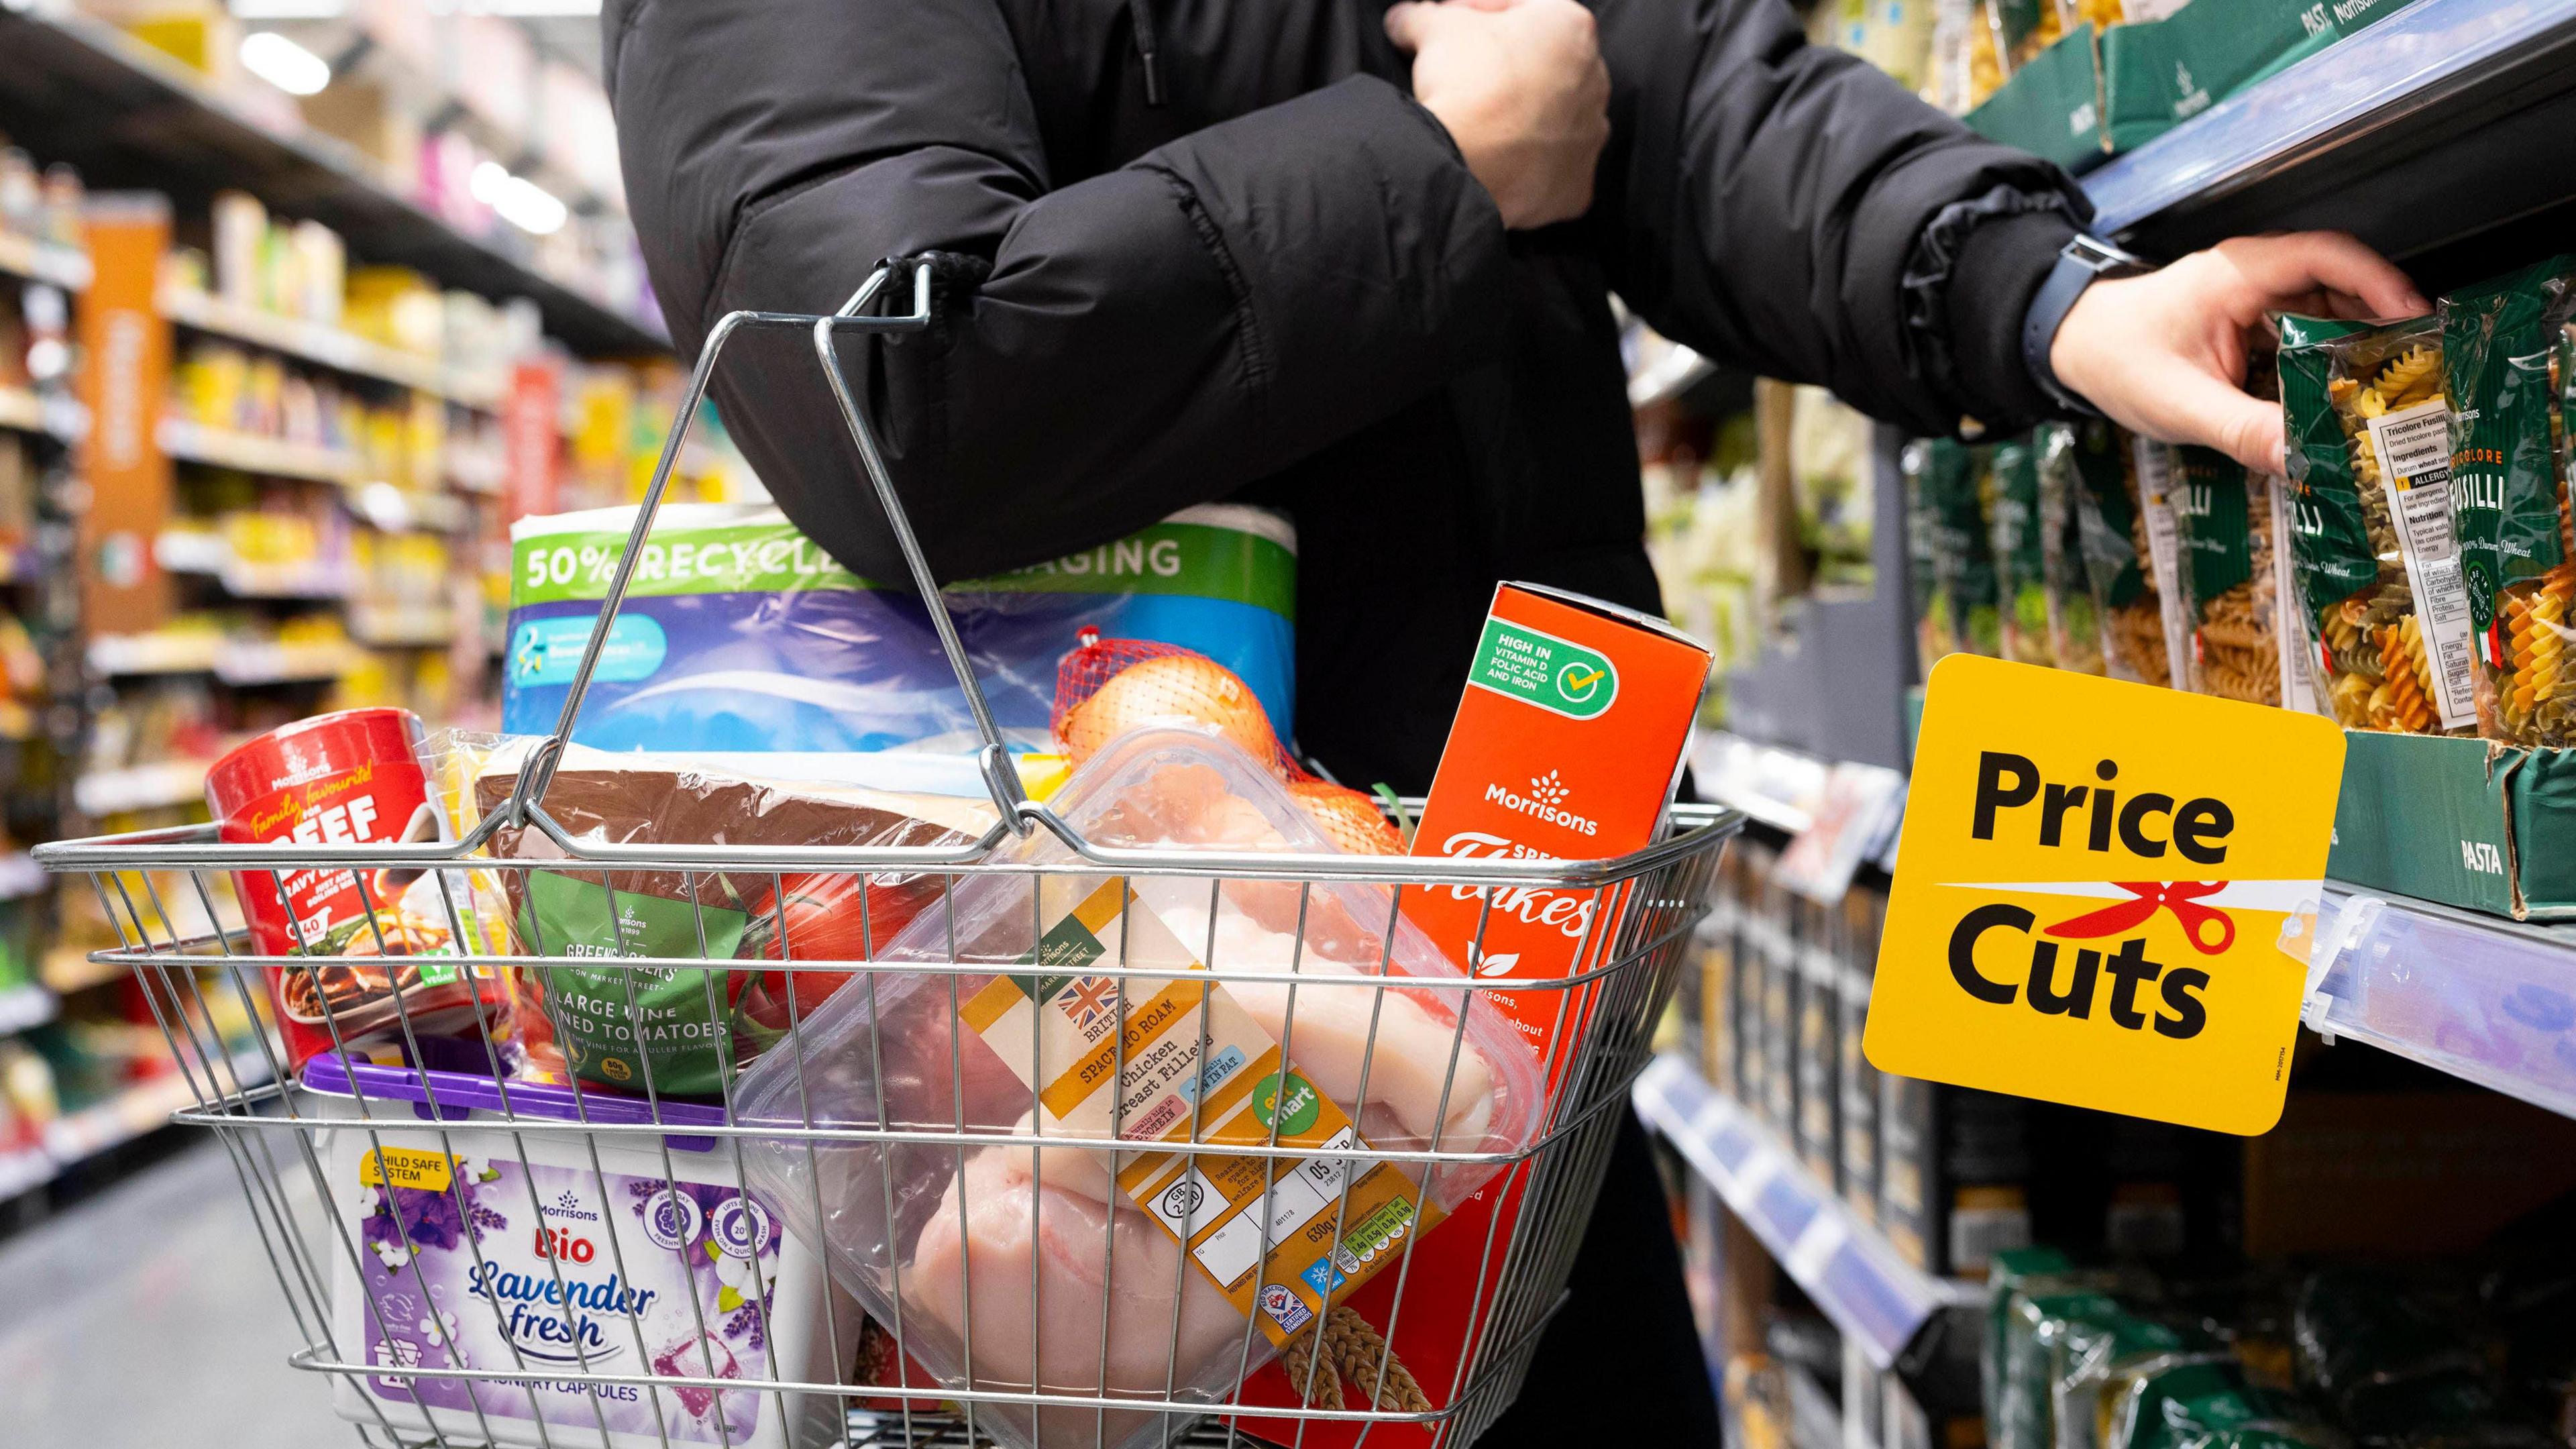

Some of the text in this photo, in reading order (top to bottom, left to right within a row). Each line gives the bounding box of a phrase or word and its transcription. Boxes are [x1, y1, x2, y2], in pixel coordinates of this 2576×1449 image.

[2387, 413, 2446, 437] Tricolore Fusilli
[2390, 431, 2432, 448] Dried tricolore
[2393, 445, 2438, 463] Ingredients
[2450, 448, 2503, 469] RICOLORE
[2397, 458, 2438, 475] Durum wheat
[2415, 488, 2445, 500] allergens,
[2450, 473, 2504, 518] FUSILLI
[2406, 503, 2417, 511] see
[2409, 511, 2444, 525] Nutrition
[2413, 527, 2434, 537] Typical
[2418, 544, 2438, 554] Energy
[2501, 539, 2531, 558] Wheat
[527, 545, 617, 588] 50%
[2320, 561, 2351, 577] Wheat
[2431, 567, 2451, 576] which
[2428, 584, 2455, 596] of which
[2430, 596, 2446, 604] Fibre
[2432, 604, 2455, 614] Protein
[2434, 614, 2447, 623] Salt
[2472, 605, 2489, 621] ITALY
[1498, 633, 1552, 661] HIGH IN
[2441, 641, 2463, 652] Energy
[1495, 645, 1548, 671] VITAMIN D
[2443, 652, 2454, 660] Fat
[1491, 657, 1548, 683] FOLIC ACID
[1487, 668, 1538, 692] AND IRON
[2449, 678, 2462, 688] Salt
[250, 794, 304, 839] Family
[302, 804, 323, 820] FOR
[1484, 783, 1598, 837] Morrisons
[1972, 751, 2235, 865] Price
[2461, 839, 2503, 875] PASTA
[306, 882, 340, 908] BOILING
[315, 877, 335, 896] JUST
[303, 918, 320, 934] 40
[619, 916, 647, 929] orrisons
[625, 927, 640, 936] 1899
[1040, 940, 1070, 967] orrisons
[425, 973, 456, 985] VEGAN
[576, 969, 658, 991] ON MARKET TREET
[1948, 904, 2210, 1039] Cuts
[557, 991, 615, 1018] LARGE
[1122, 1029, 1140, 1051] TO
[1138, 998, 1177, 1035] ROAM
[586, 1040, 608, 1051] VINE
[611, 1044, 629, 1054] FOR
[647, 1046, 677, 1054] ULLER
[606, 1060, 624, 1071] 80g
[1121, 1039, 1178, 1089] Chicken
[1207, 1055, 1239, 1085] IN FAT
[1109, 1077, 1161, 1121] reast
[1125, 1099, 1174, 1140] Naturally high in
[1135, 1108, 1177, 1140] PROTEIN
[374, 1155, 441, 1172] CHILD SAFE
[1215, 1159, 1241, 1181] Reared
[1227, 1166, 1248, 1184] space
[1247, 1159, 1257, 1167] to
[1309, 1159, 1330, 1181] 05
[373, 1165, 421, 1181] SSTEM
[1236, 1175, 1250, 1187] for
[1324, 1171, 1342, 1187] 23812
[1232, 1179, 1260, 1203] welfare
[1356, 1179, 1368, 1189] Keep
[676, 1193, 690, 1204] DAY
[1171, 1187, 1185, 1201] GB
[539, 1204, 598, 1222] Morrisons
[722, 1201, 739, 1212] LIFTS
[1374, 1205, 1412, 1223] Sugars 0.1g
[1275, 1209, 1295, 1227] 401178
[1381, 1217, 1397, 1230] 0.1g
[718, 1237, 728, 1248] ON
[757, 1225, 767, 1245] WASH
[1214, 1230, 1226, 1242] Price
[1305, 1220, 1334, 1243] 630g
[1366, 1228, 1383, 1242] 0.5g
[535, 1227, 594, 1263] Bio
[1195, 1248, 1205, 1257] TG
[1352, 1240, 1367, 1253] 1.4g
[1364, 1252, 1373, 1260] 2%
[470, 1260, 655, 1316] Lavender
[1228, 1276, 1247, 1295] PREPARED
[1259, 1285, 1286, 1307] RED TRACTOR
[504, 1303, 604, 1347] fresh
[1283, 1307, 1307, 1328] CERTIFIED
[1285, 1311, 1313, 1334] STANDARDS
[556, 1381, 638, 1401] CAPULES
